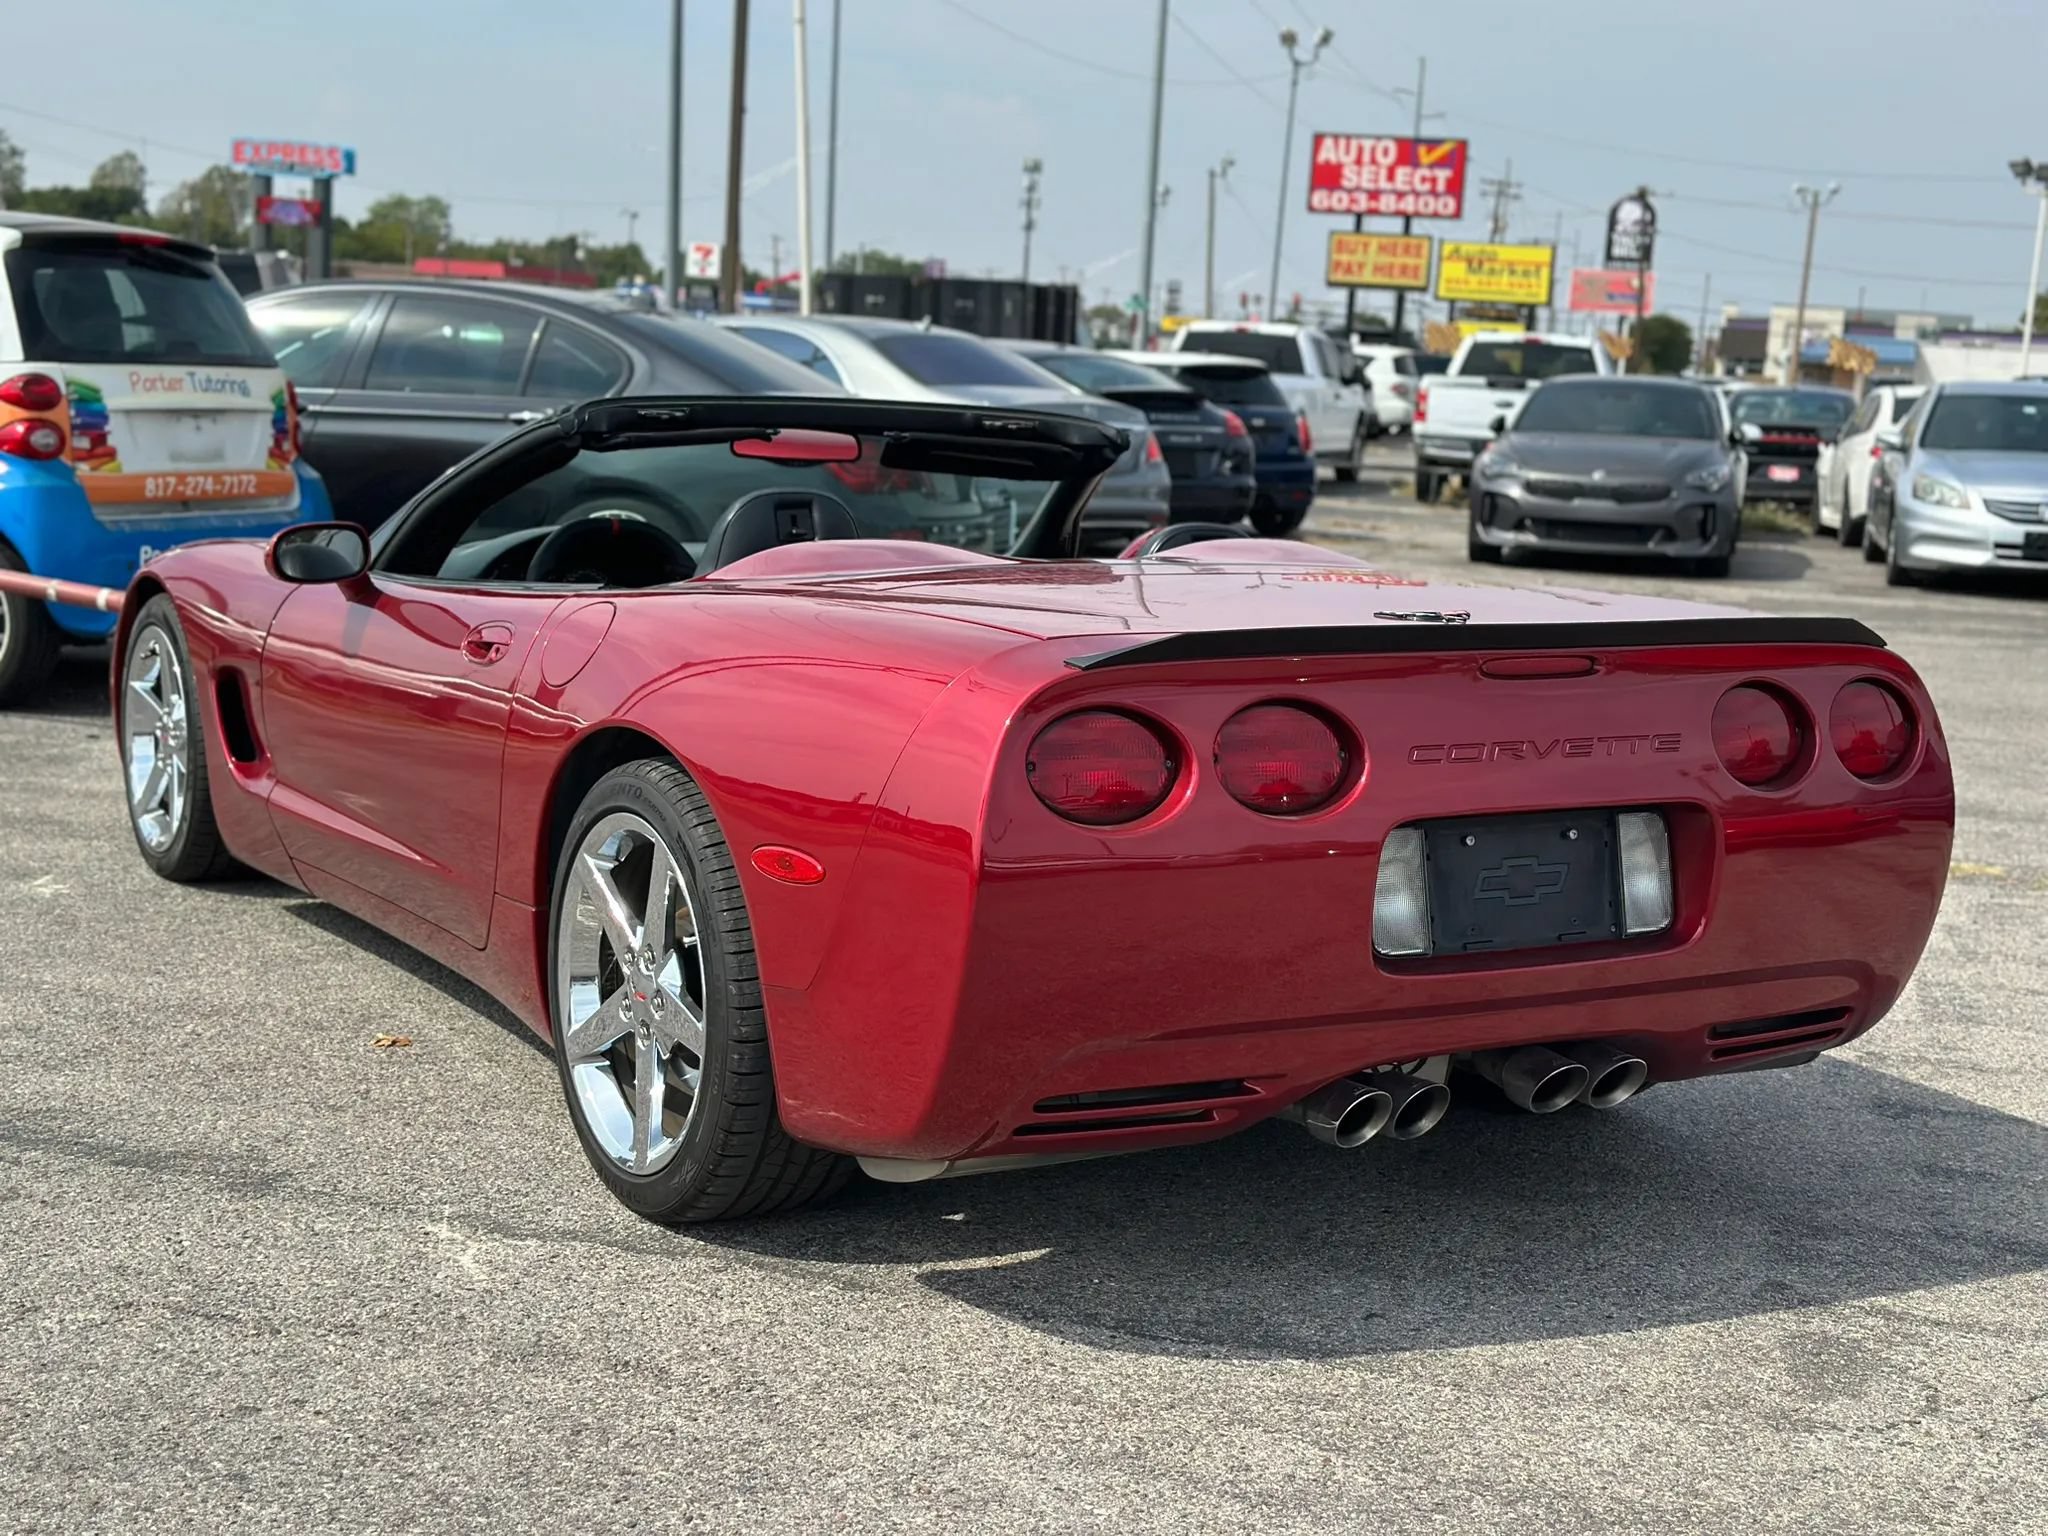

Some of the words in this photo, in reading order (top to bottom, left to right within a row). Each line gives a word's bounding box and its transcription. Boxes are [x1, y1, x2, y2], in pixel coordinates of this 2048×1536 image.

[233, 140, 343, 171] EXPRESS
[1316, 137, 1398, 166] AUTO
[1340, 164, 1453, 193] SELECT
[1310, 188, 1457, 215] 603-8400
[1334, 238, 1370, 255] BUY
[1377, 240, 1424, 258] HERE
[1332, 259, 1367, 277] PAY
[1371, 262, 1422, 280] HERE
[128, 371, 185, 391] Porter
[186, 371, 252, 397] Tutoring
[144, 474, 257, 498] 817-274-7172
[1408, 732, 1682, 765] CORVETTE
